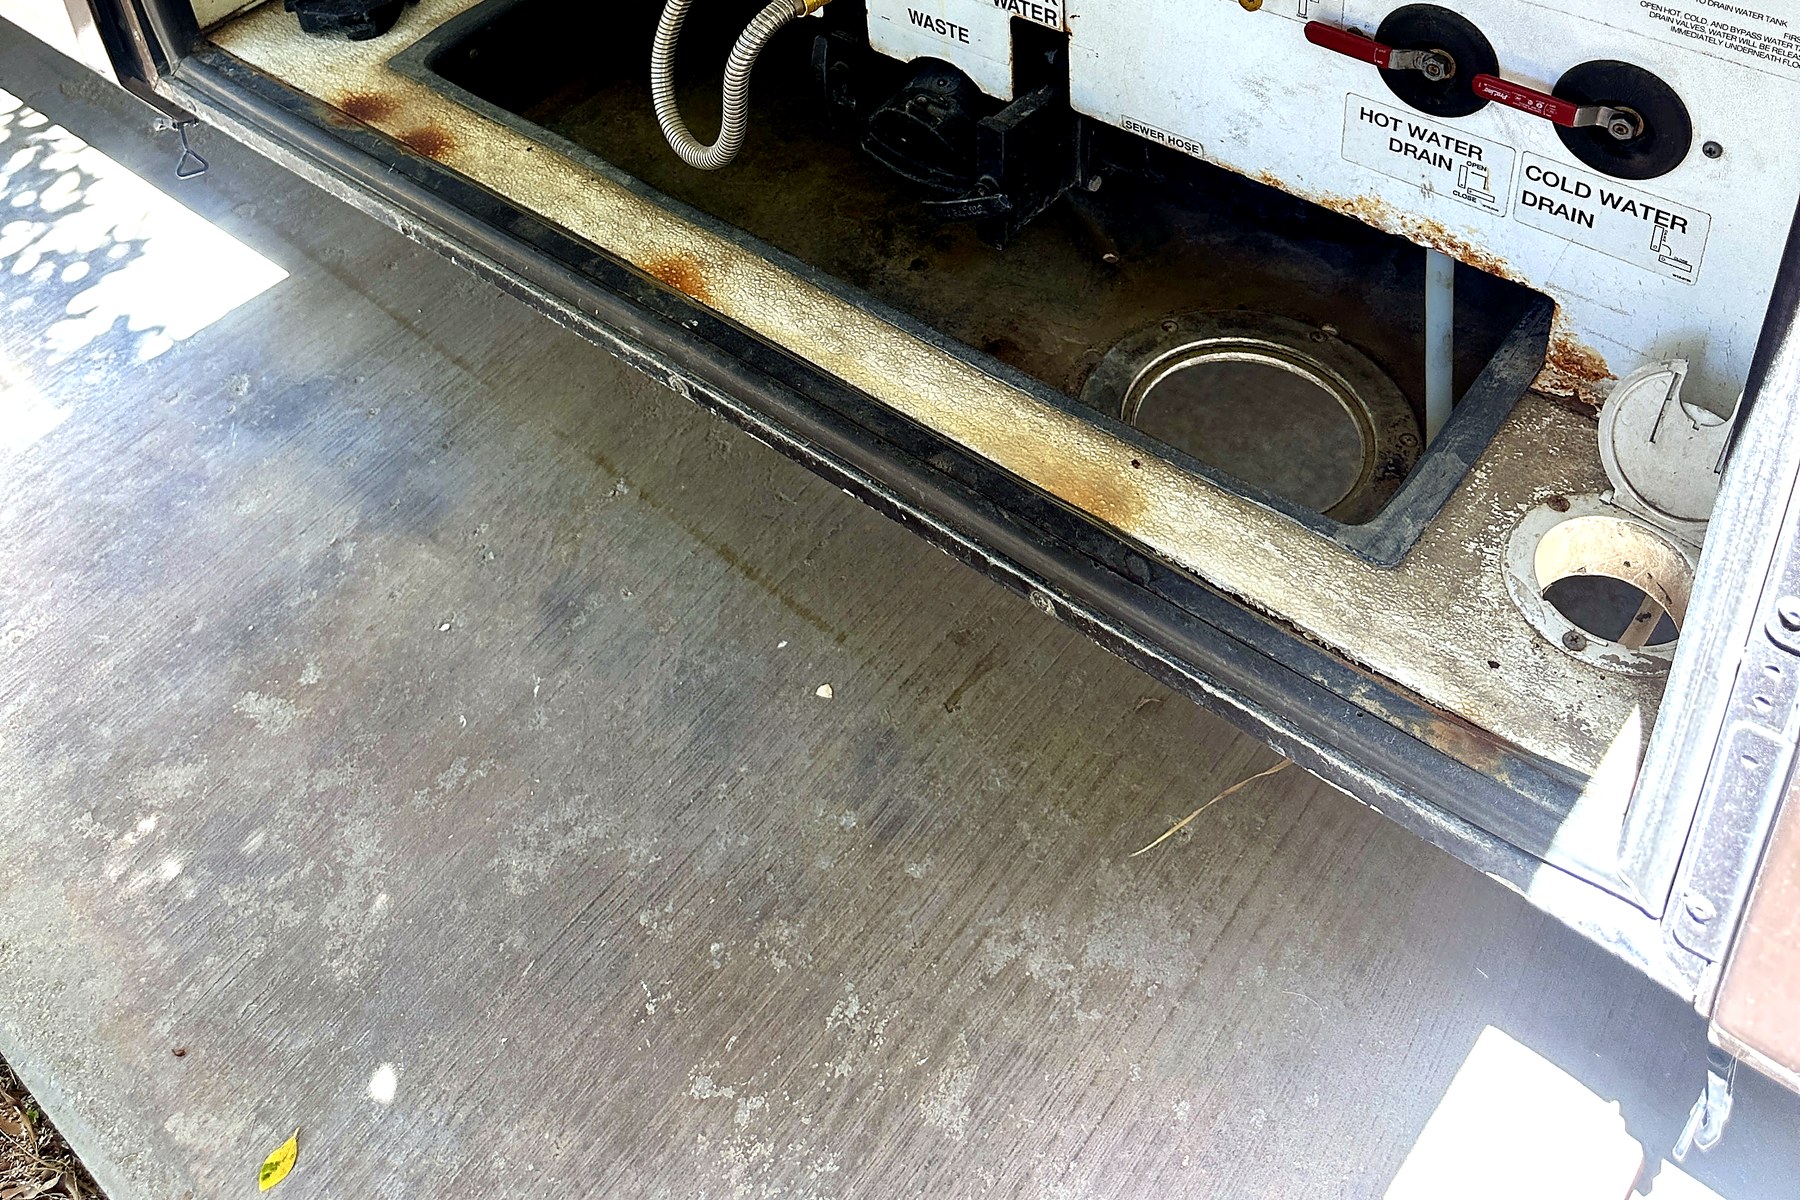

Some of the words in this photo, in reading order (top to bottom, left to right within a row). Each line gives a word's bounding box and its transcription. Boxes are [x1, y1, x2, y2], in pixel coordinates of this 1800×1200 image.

[907, 8, 970, 44] WASTE
[1640, 0, 1663, 13] OPEN
[1709, 20, 1729, 31] AND
[1730, 25, 1762, 41] BYPASS
[1763, 35, 1793, 50] WATER
[1649, 11, 1674, 24] DRAIN
[1708, 28, 1737, 42] WATER
[1738, 37, 1758, 49] WILL
[1759, 43, 1770, 52] BE
[1707, 0, 1734, 13] DRAIN
[1734, 7, 1764, 22] WATER
[1765, 16, 1788, 28] TANK
[1670, 25, 1724, 46] IMMEDIATELY
[1724, 42, 1782, 64] UNDERNEATH
[1125, 120, 1165, 141] SEWER
[1168, 136, 1199, 154] HOSE
[1360, 107, 1402, 132] HOT
[1408, 123, 1483, 161] WATER
[1389, 137, 1453, 171] DRAIN
[1466, 160, 1487, 172] OPEN
[1452, 190, 1477, 203] CLOSE
[1521, 190, 1595, 228] DRAIN
[1525, 165, 1592, 199] COLD
[1600, 189, 1688, 234] WATER
